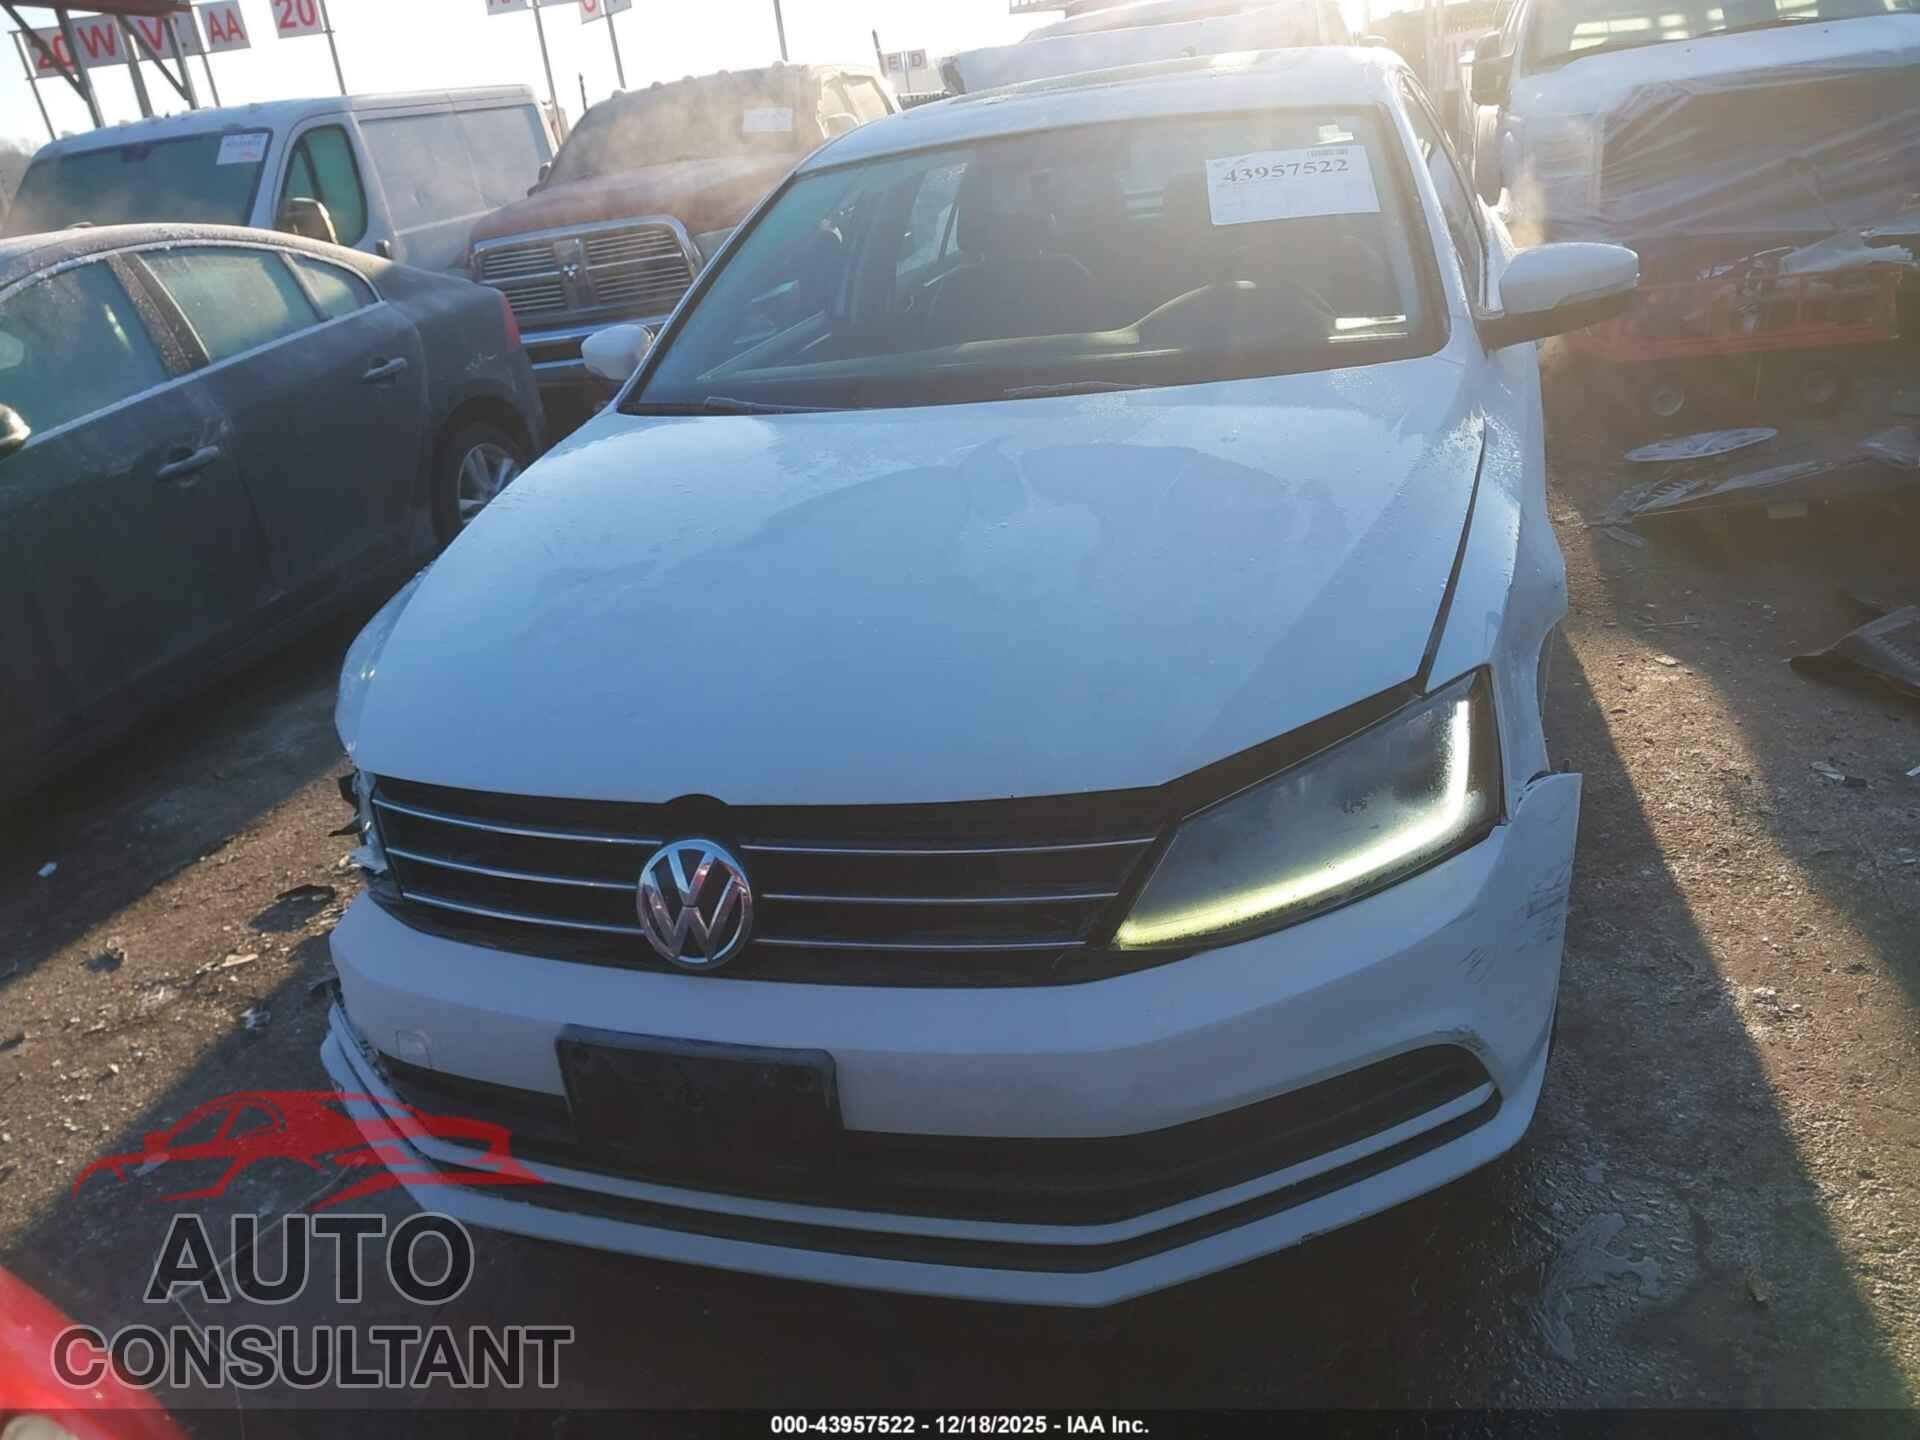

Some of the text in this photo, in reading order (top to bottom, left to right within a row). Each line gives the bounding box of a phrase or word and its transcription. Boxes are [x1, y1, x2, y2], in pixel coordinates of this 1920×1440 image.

[76, 23, 115, 59] W
[208, 9, 244, 44] AA
[1223, 158, 1350, 183] 43957522
